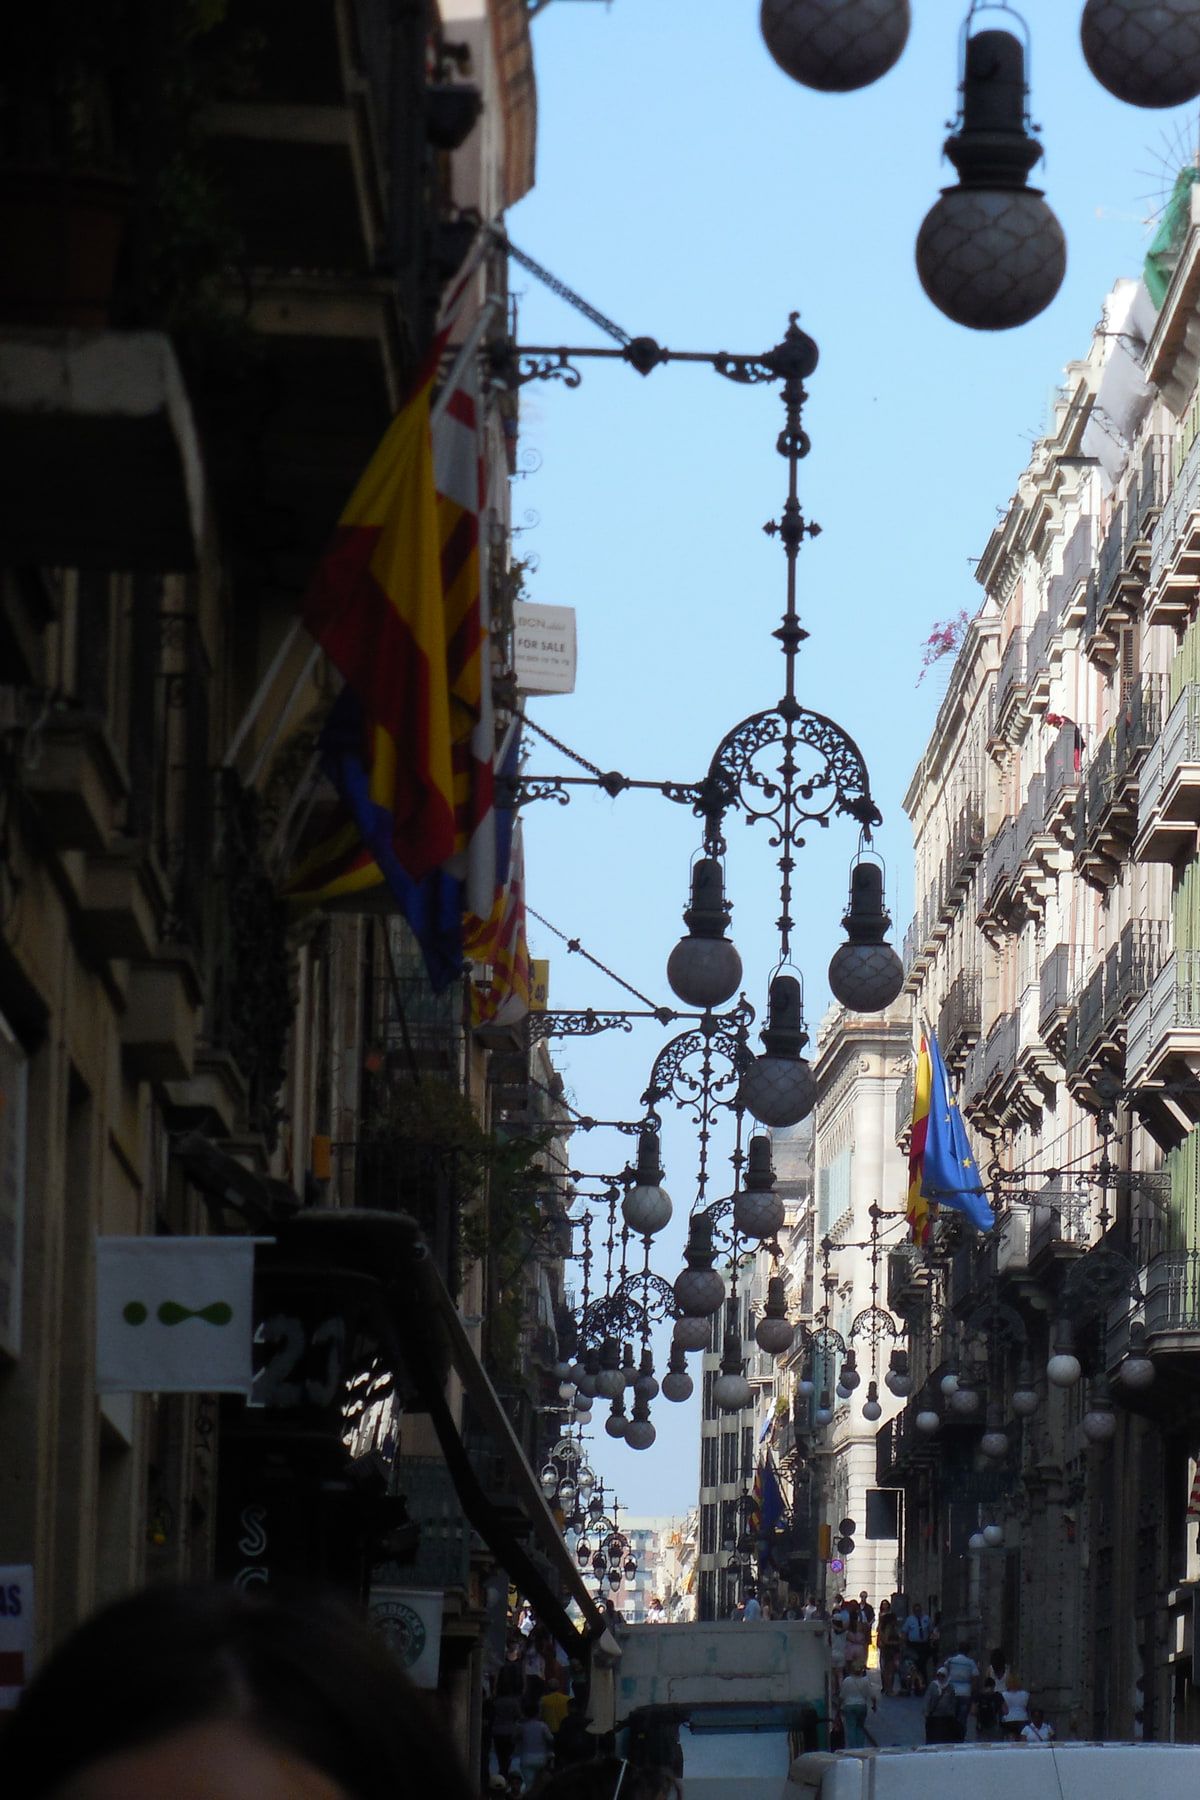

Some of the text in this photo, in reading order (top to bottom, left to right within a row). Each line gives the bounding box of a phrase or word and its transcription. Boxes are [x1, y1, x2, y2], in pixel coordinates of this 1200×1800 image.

[518, 638, 565, 653] FOR SALE
[372, 1601, 424, 1638] RBUCKS
